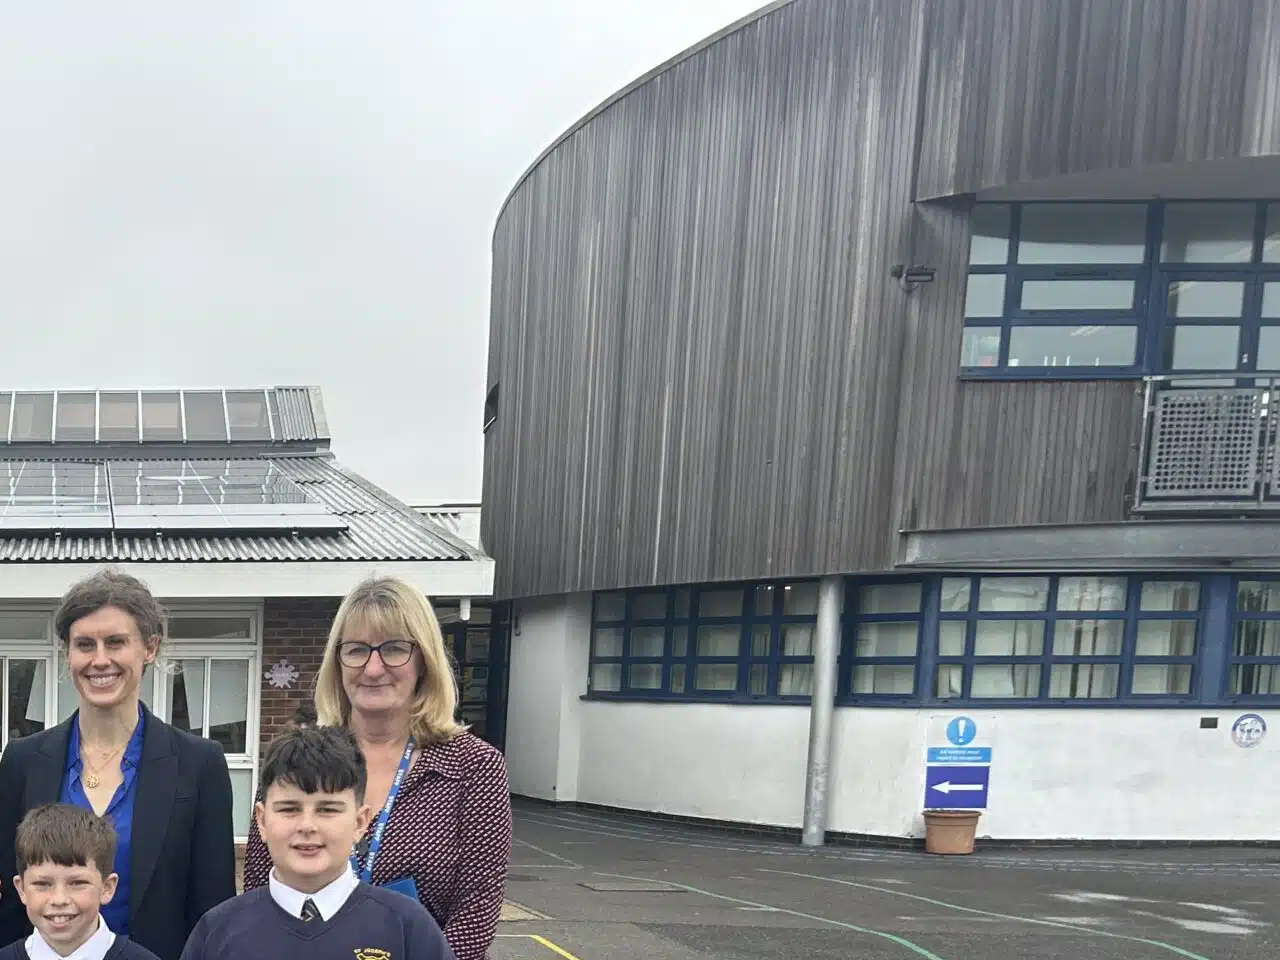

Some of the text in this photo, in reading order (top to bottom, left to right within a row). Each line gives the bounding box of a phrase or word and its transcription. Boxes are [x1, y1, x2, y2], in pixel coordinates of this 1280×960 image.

[395, 769, 404, 785] STAFF
[385, 796, 394, 813] STAFF
[375, 823, 385, 841] STAFF
[366, 852, 375, 871] STAFF
